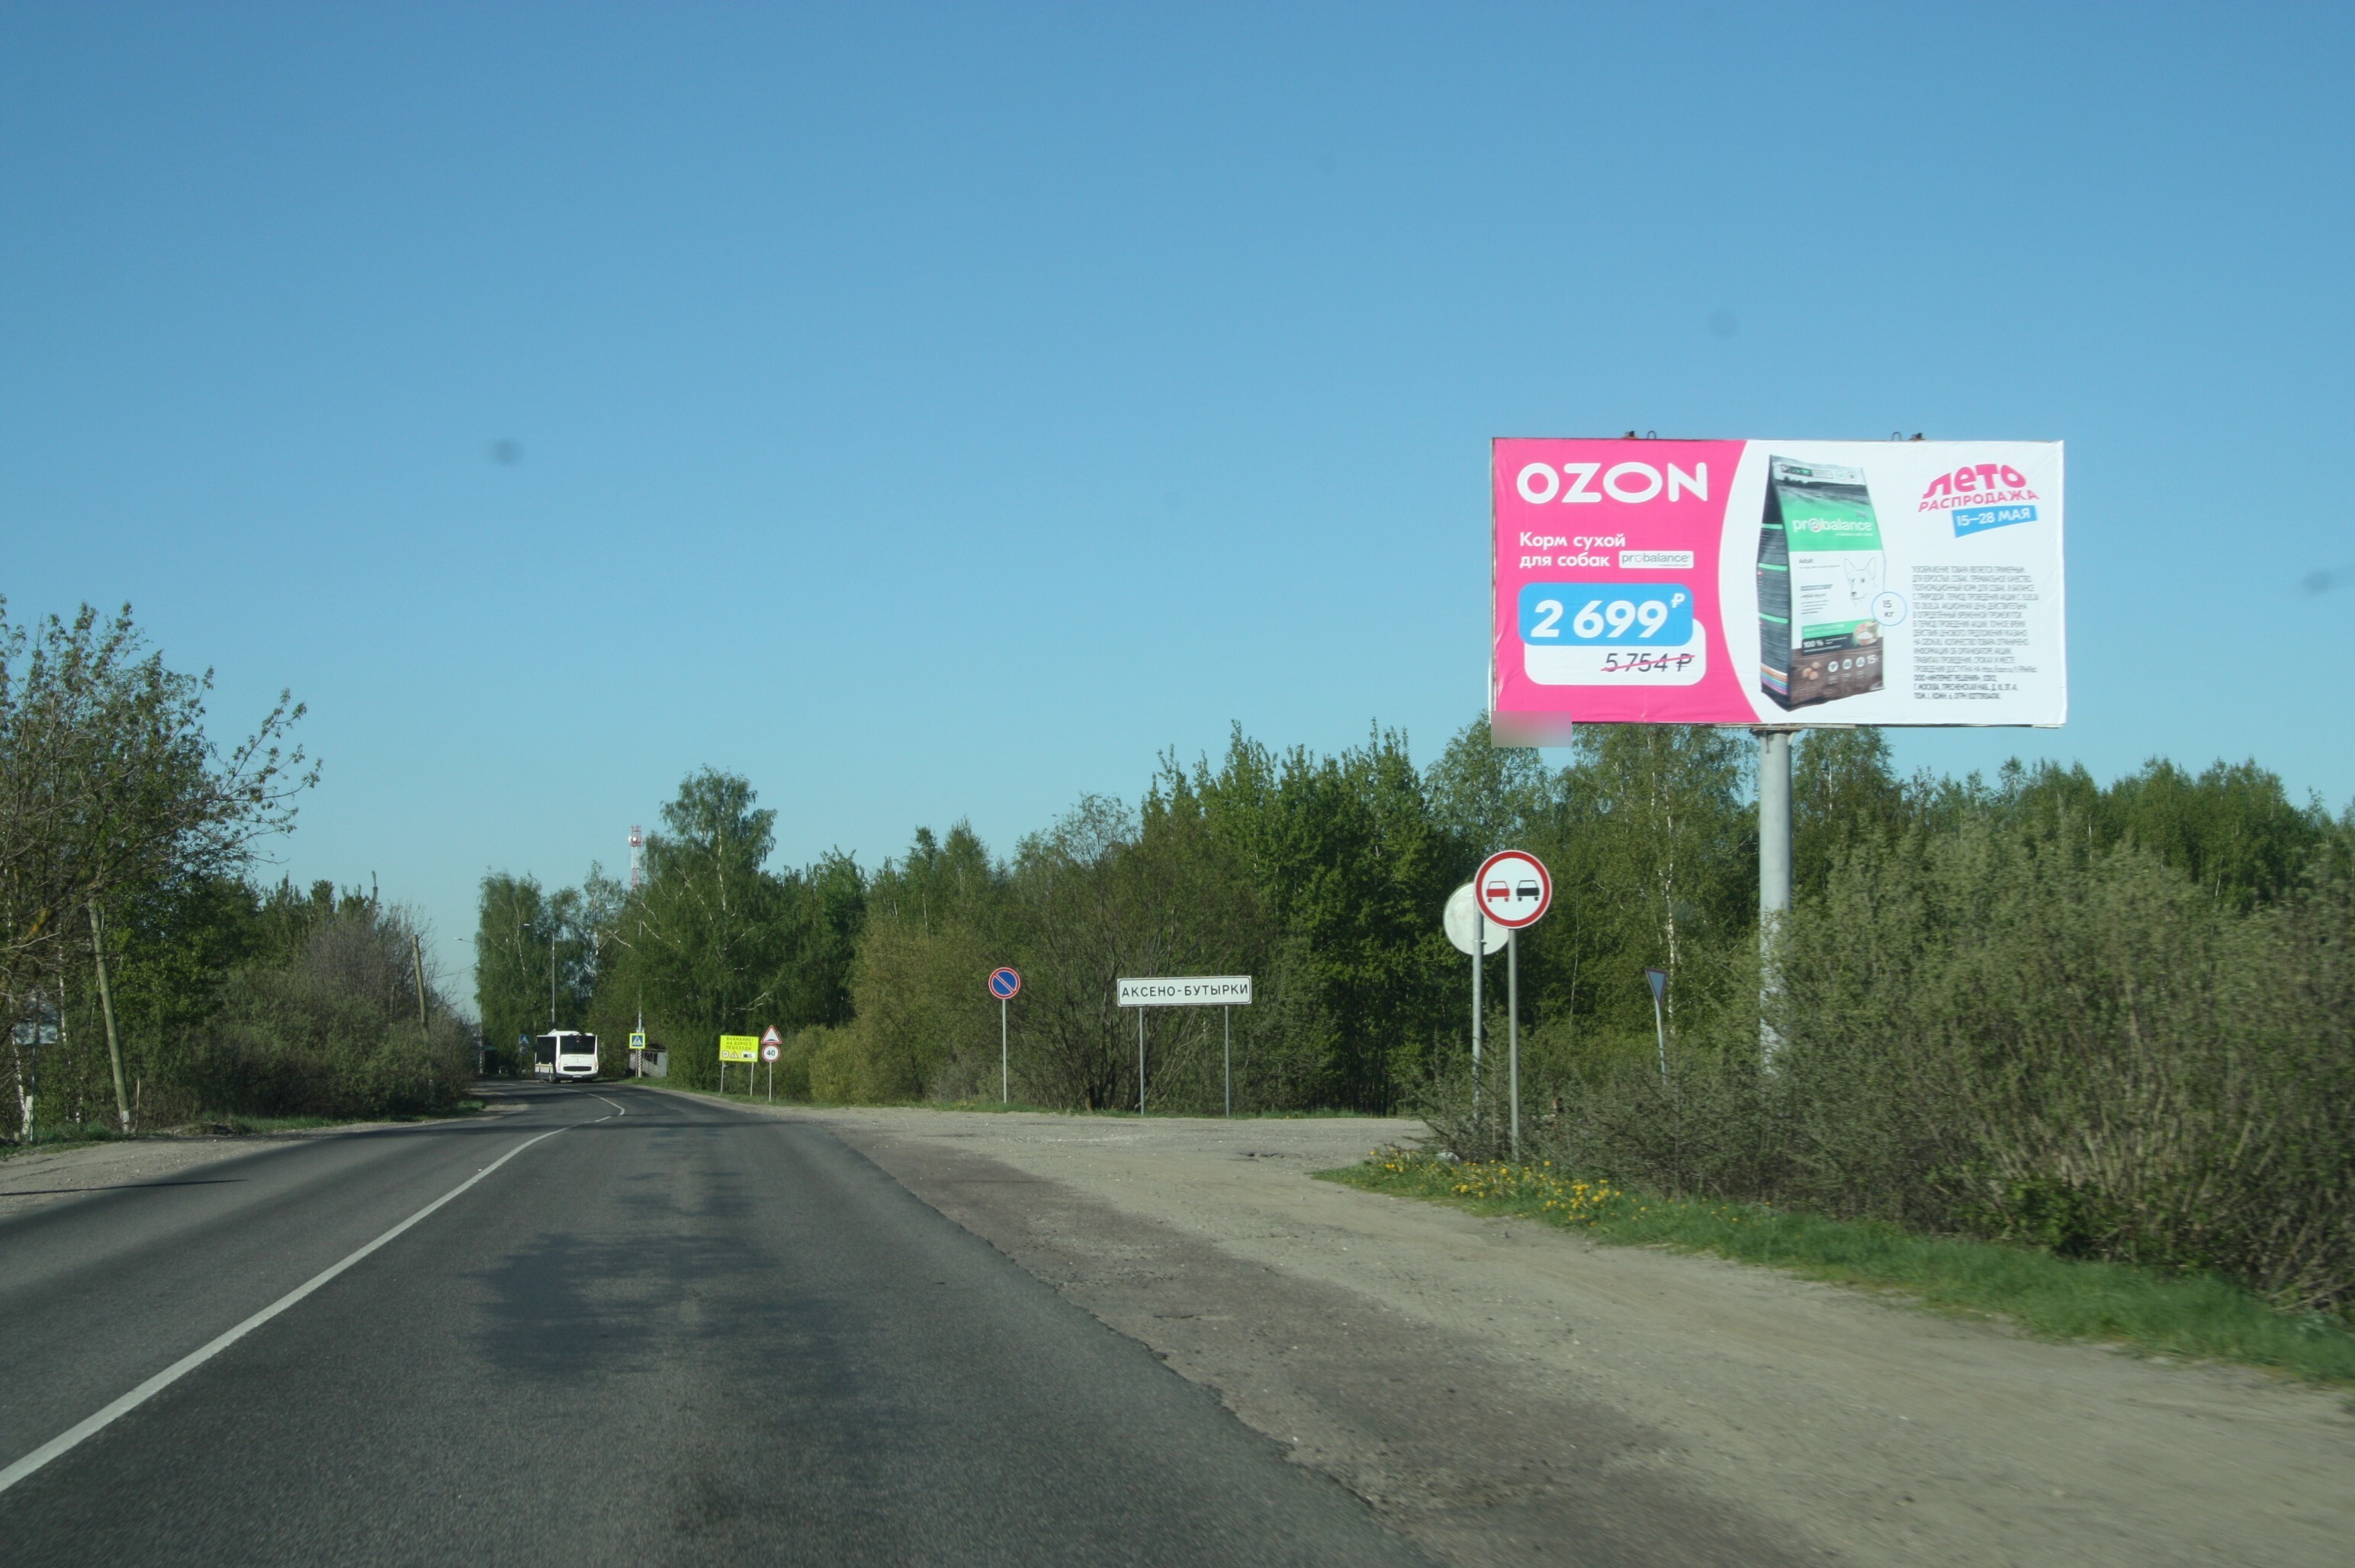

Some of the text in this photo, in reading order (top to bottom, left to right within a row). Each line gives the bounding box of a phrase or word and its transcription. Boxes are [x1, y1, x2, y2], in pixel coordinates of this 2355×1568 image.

[1516, 461, 1708, 504] OZON
[1917, 490, 2040, 512] РАСПРОДАЖА
[1998, 507, 2031, 522] МАЯ
[1519, 532, 1626, 551] Корм сухой
[1519, 551, 1611, 569] для собак
[1621, 552, 1688, 565] probalance
[1121, 984, 1248, 998] АКСЕНО-БУТЫРКИ
